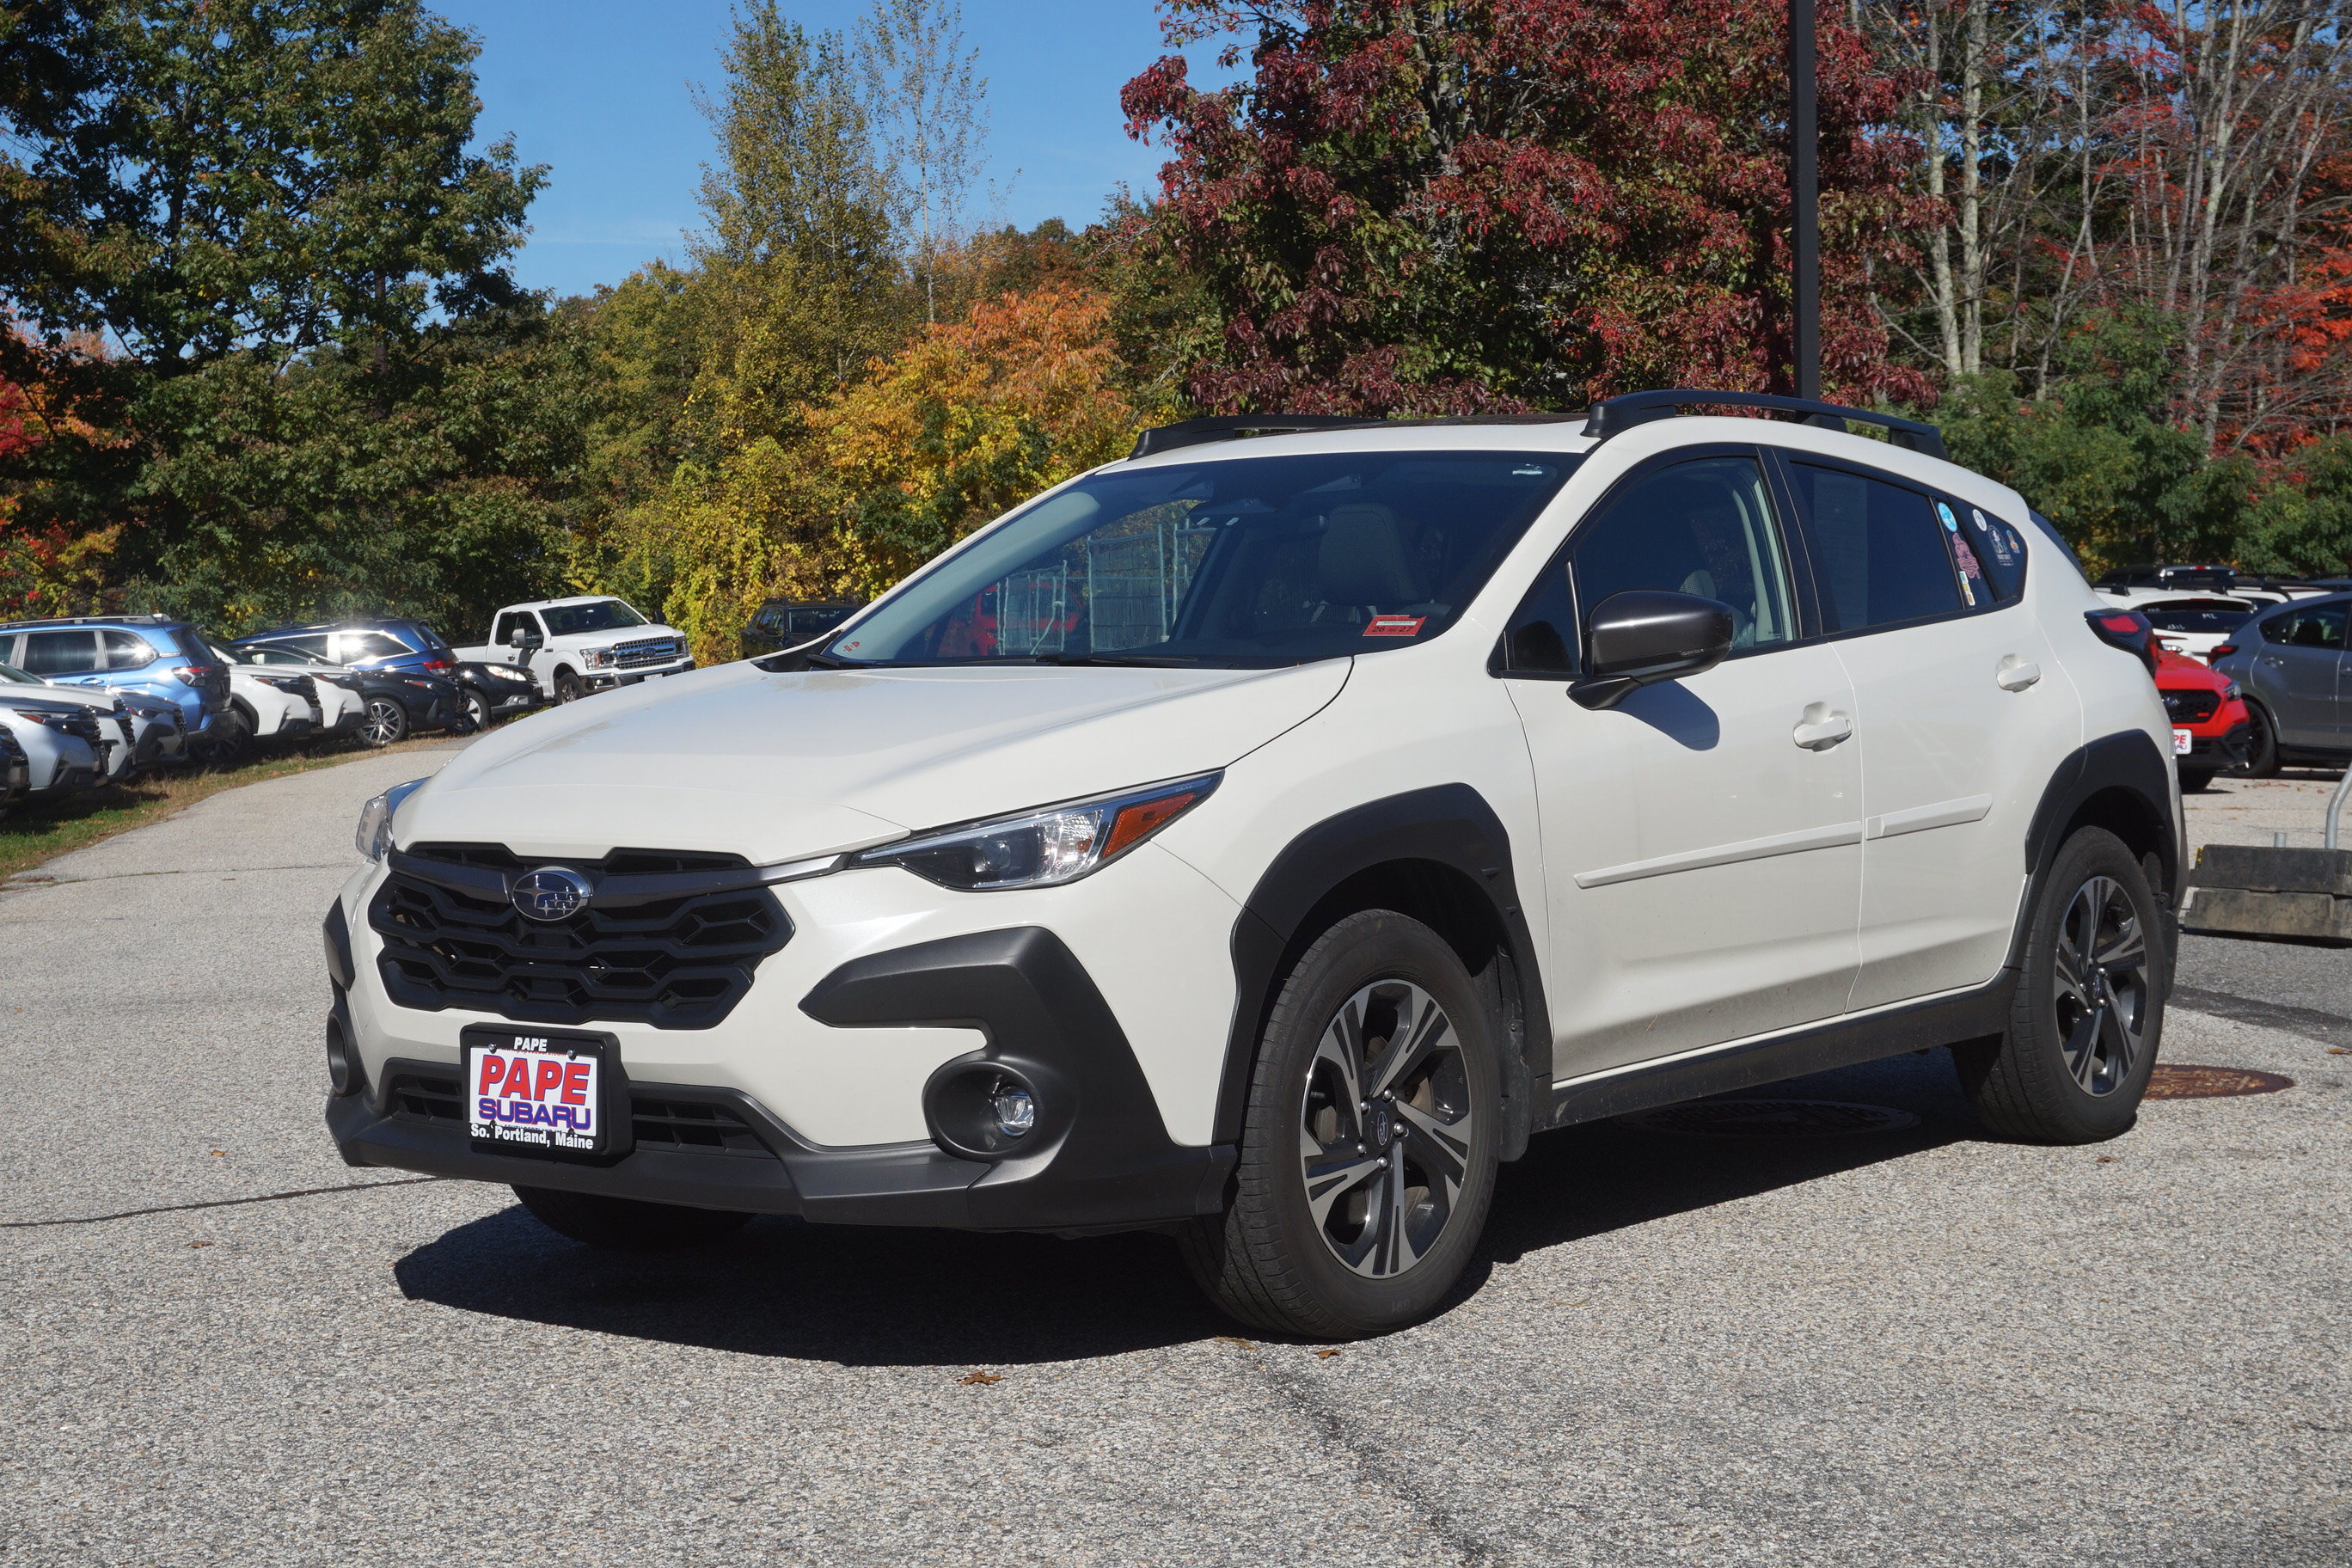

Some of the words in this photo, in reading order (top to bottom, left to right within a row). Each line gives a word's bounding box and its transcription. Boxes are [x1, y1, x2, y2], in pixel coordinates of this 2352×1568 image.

[2173, 735, 2186, 744] PE
[514, 1037, 548, 1051] PAPE
[478, 1055, 591, 1106] PAPE
[478, 1098, 591, 1130] SUBARU
[470, 1123, 490, 1138] So.
[494, 1125, 550, 1148] Portland,
[555, 1131, 594, 1150] Maine
